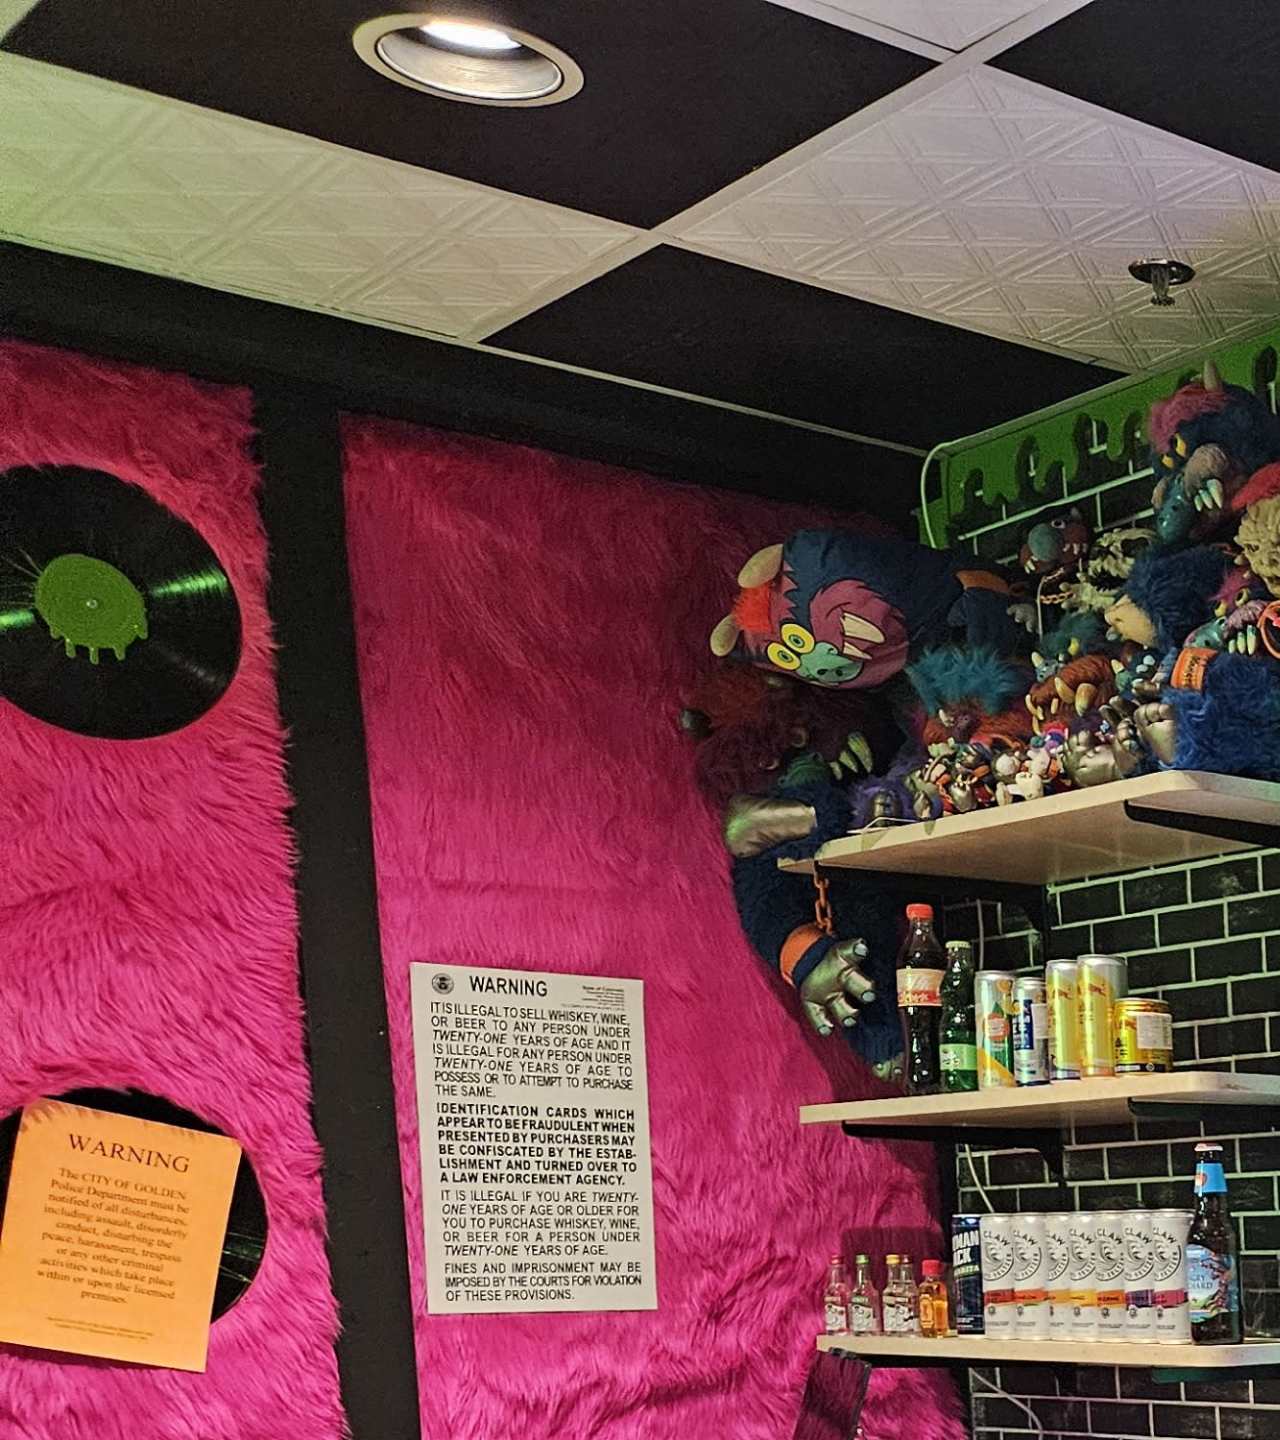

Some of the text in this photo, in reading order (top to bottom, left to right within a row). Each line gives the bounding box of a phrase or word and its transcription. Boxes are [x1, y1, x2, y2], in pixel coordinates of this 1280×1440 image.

[470, 976, 547, 996] WARNING
[431, 1002, 440, 1013] IT
[442, 1003, 452, 1014] IS
[454, 1004, 501, 1017] ILLEGAL
[503, 1007, 518, 1018] TO
[520, 1008, 546, 1020] SELL
[432, 1016, 630, 1037] OR BEER TO ANY PERSON UNDER
[433, 1031, 630, 1051] TWENTY-ONE YEARS OF AGE AND IT
[433, 1044, 631, 1063] IS ILLEGAL FOR ANY PERSON UNDER
[435, 1058, 632, 1076] TWENTY-ONE YEARS OF AGE TO
[435, 1072, 632, 1090] POSSESS OR TO ATTEMPT TO PURCHASE
[435, 1085, 457, 1096] THE
[437, 1103, 634, 1120] IDENTIFICATION CARDS WHICH
[69, 1133, 190, 1174] WARNING
[114, 1178, 129, 1189] OF
[134, 1182, 187, 1200] GOLDEN
[983, 1229, 1011, 1246] CLAW
[1013, 1228, 1037, 1246] CLAW
[1050, 1232, 1066, 1246] LAW
[1069, 1228, 1095, 1245] CLAW
[1097, 1227, 1123, 1245] CLAW
[1125, 1227, 1152, 1245] CLAW
[1153, 1226, 1177, 1244] CLAW
[953, 1249, 972, 1266] CK
